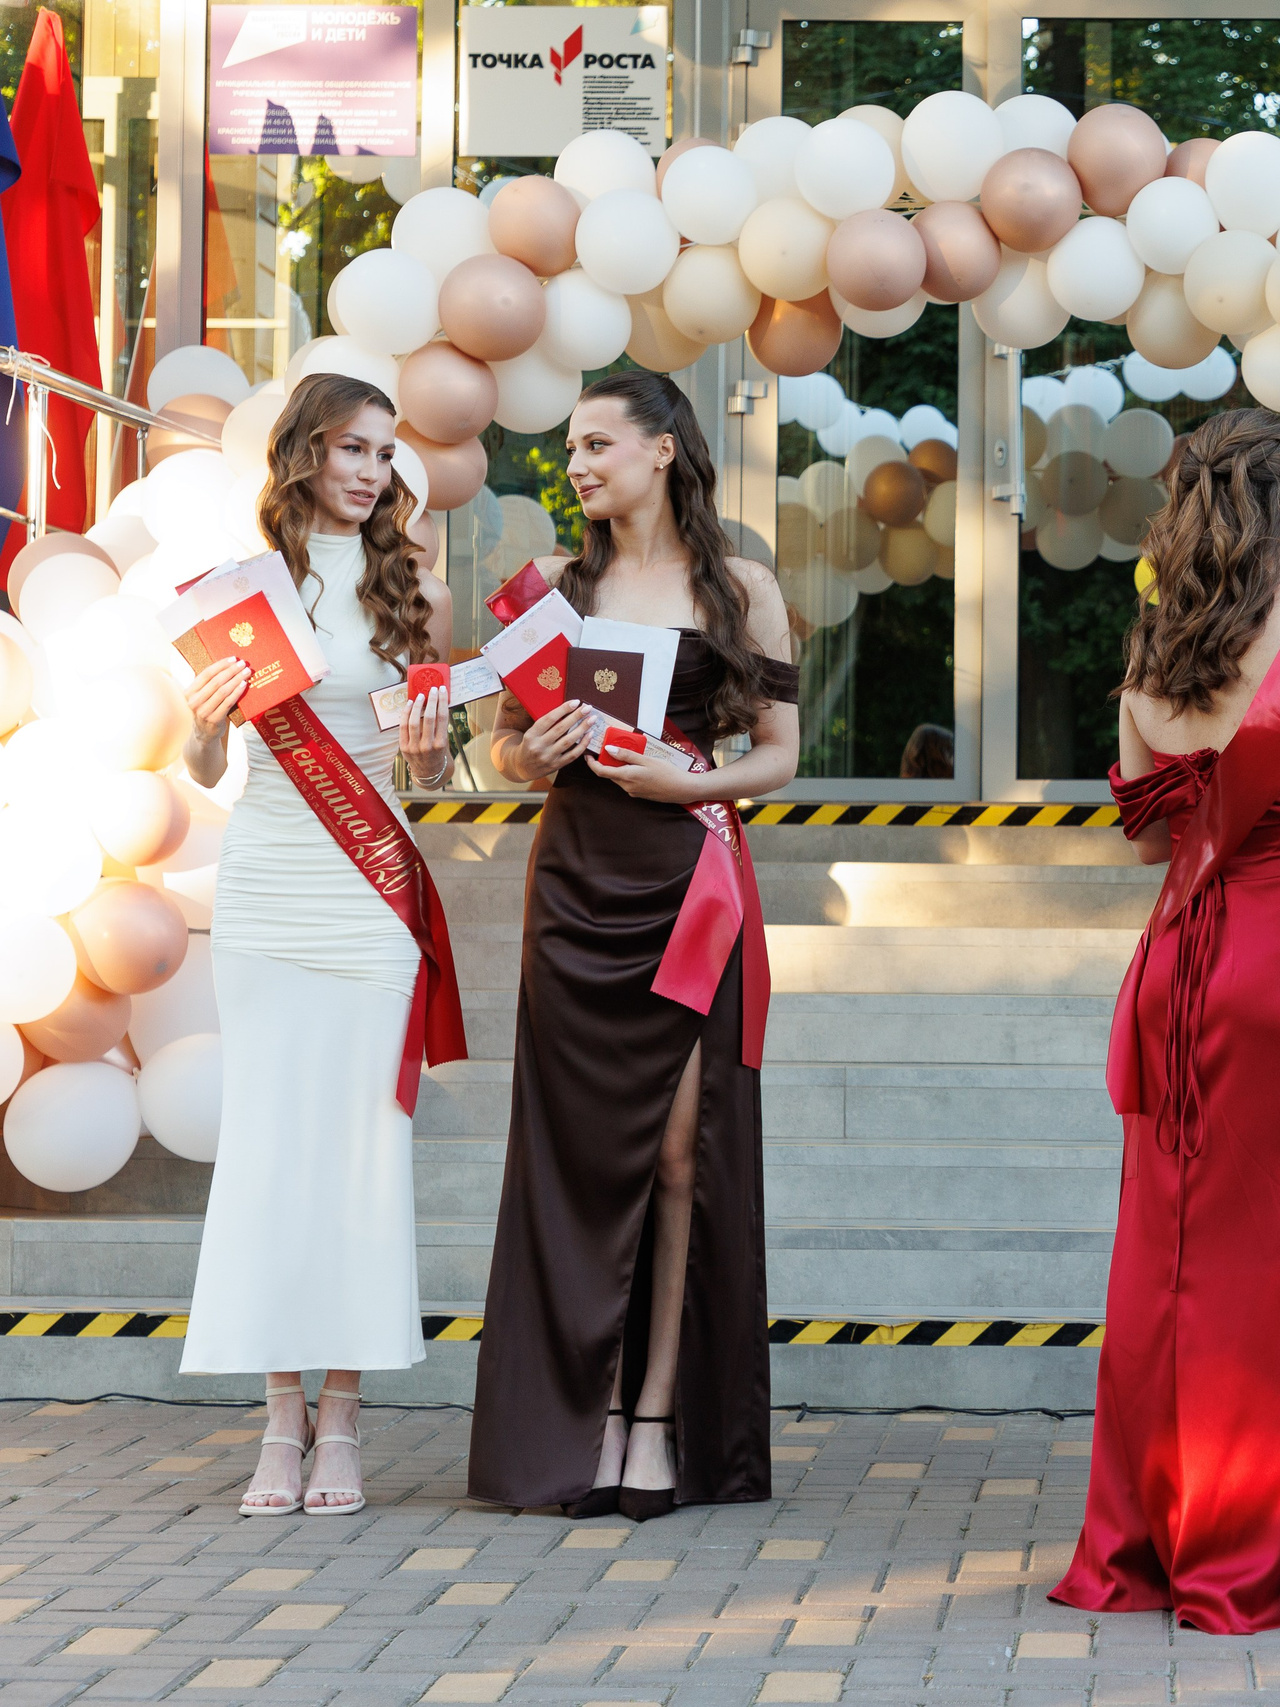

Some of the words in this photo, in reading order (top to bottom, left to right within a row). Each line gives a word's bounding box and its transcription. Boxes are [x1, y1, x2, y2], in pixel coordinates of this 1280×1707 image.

[311, 8, 401, 26] МОЛОДЁЖЬ
[311, 29, 322, 41] И
[324, 28, 366, 43] ДЕТИ
[468, 53, 544, 69] ТОЧКА
[583, 53, 656, 69] РОСТА
[285, 697, 322, 744] Новикова
[319, 741, 366, 796] Екатерина
